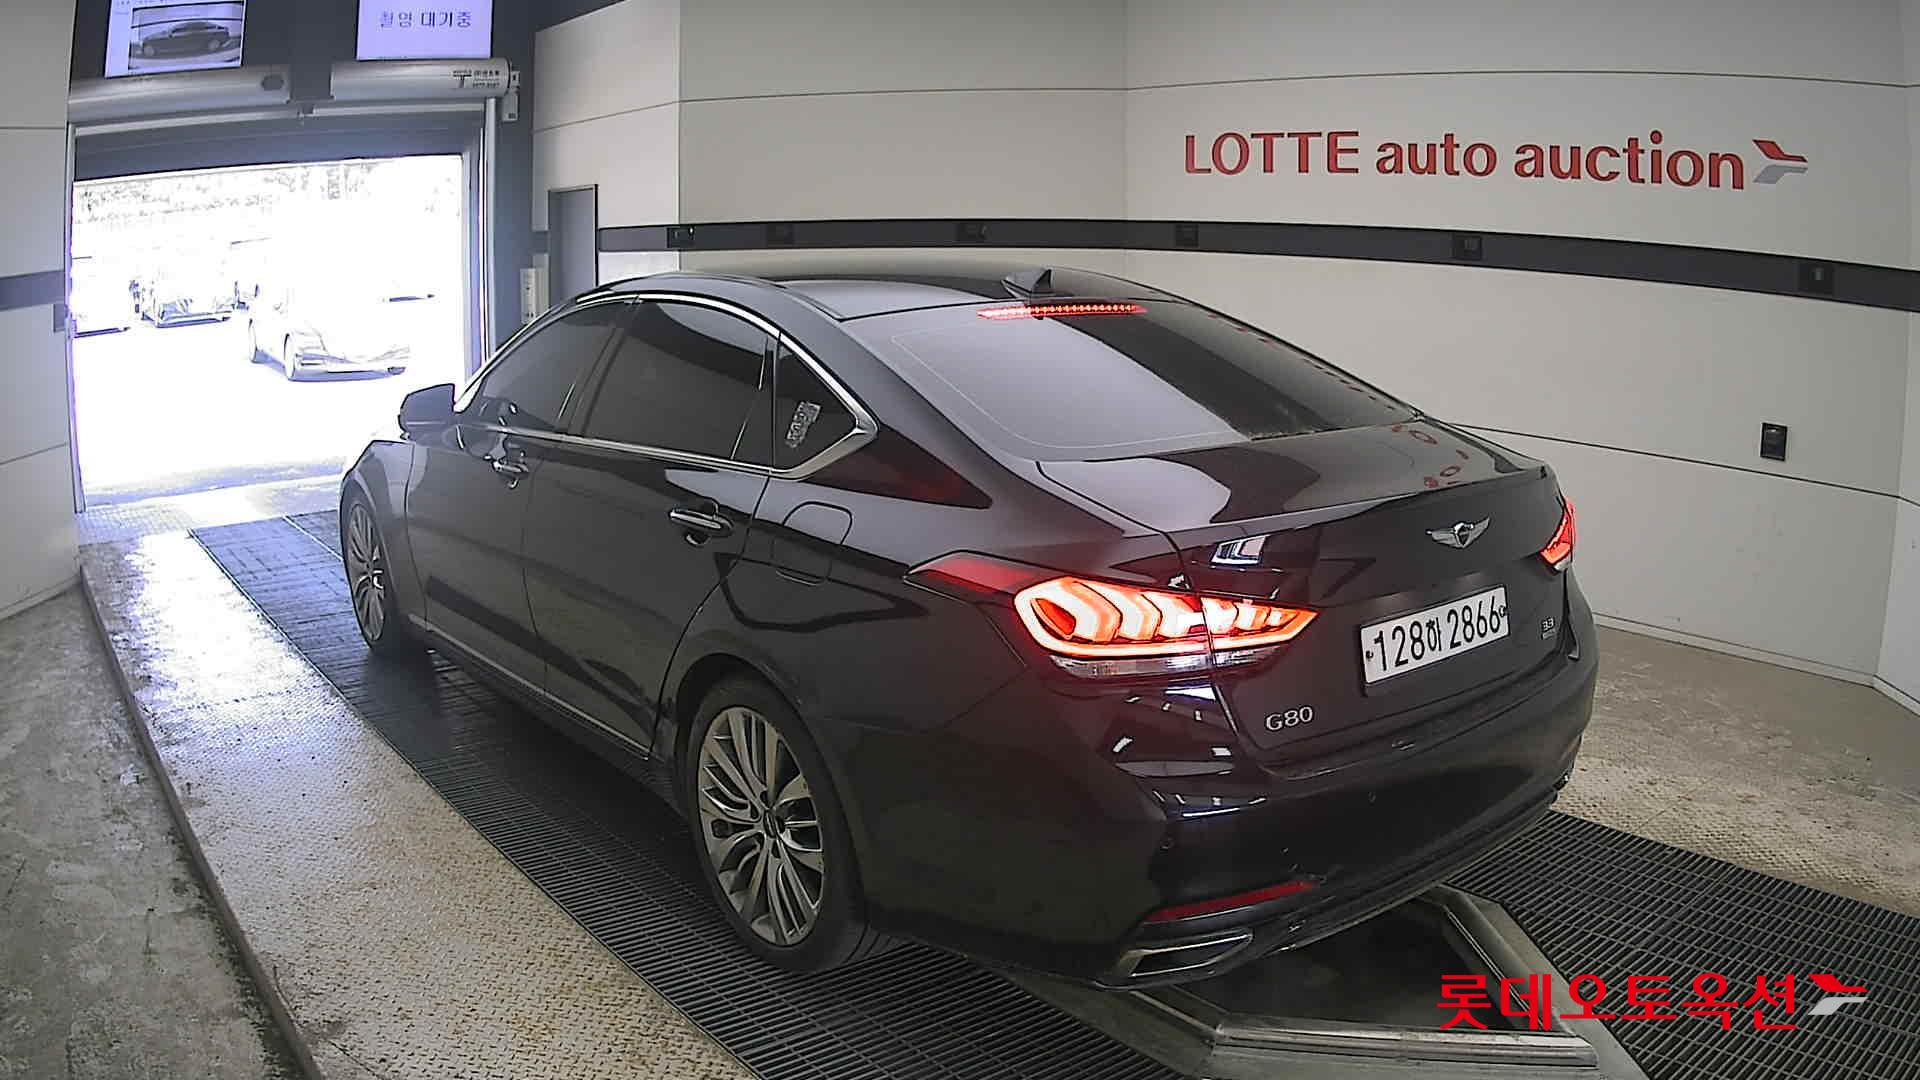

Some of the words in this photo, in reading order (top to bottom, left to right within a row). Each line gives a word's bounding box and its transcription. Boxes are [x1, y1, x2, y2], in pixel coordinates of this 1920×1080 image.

[420, 10, 472, 28] 대기중
[1185, 130, 1360, 175] LOTTE
[1375, 132, 1498, 178] auto
[1513, 129, 1745, 191] auction
[1374, 617, 1442, 672] 128하
[1447, 595, 1501, 649] 2866
[1266, 706, 1313, 731] G80
